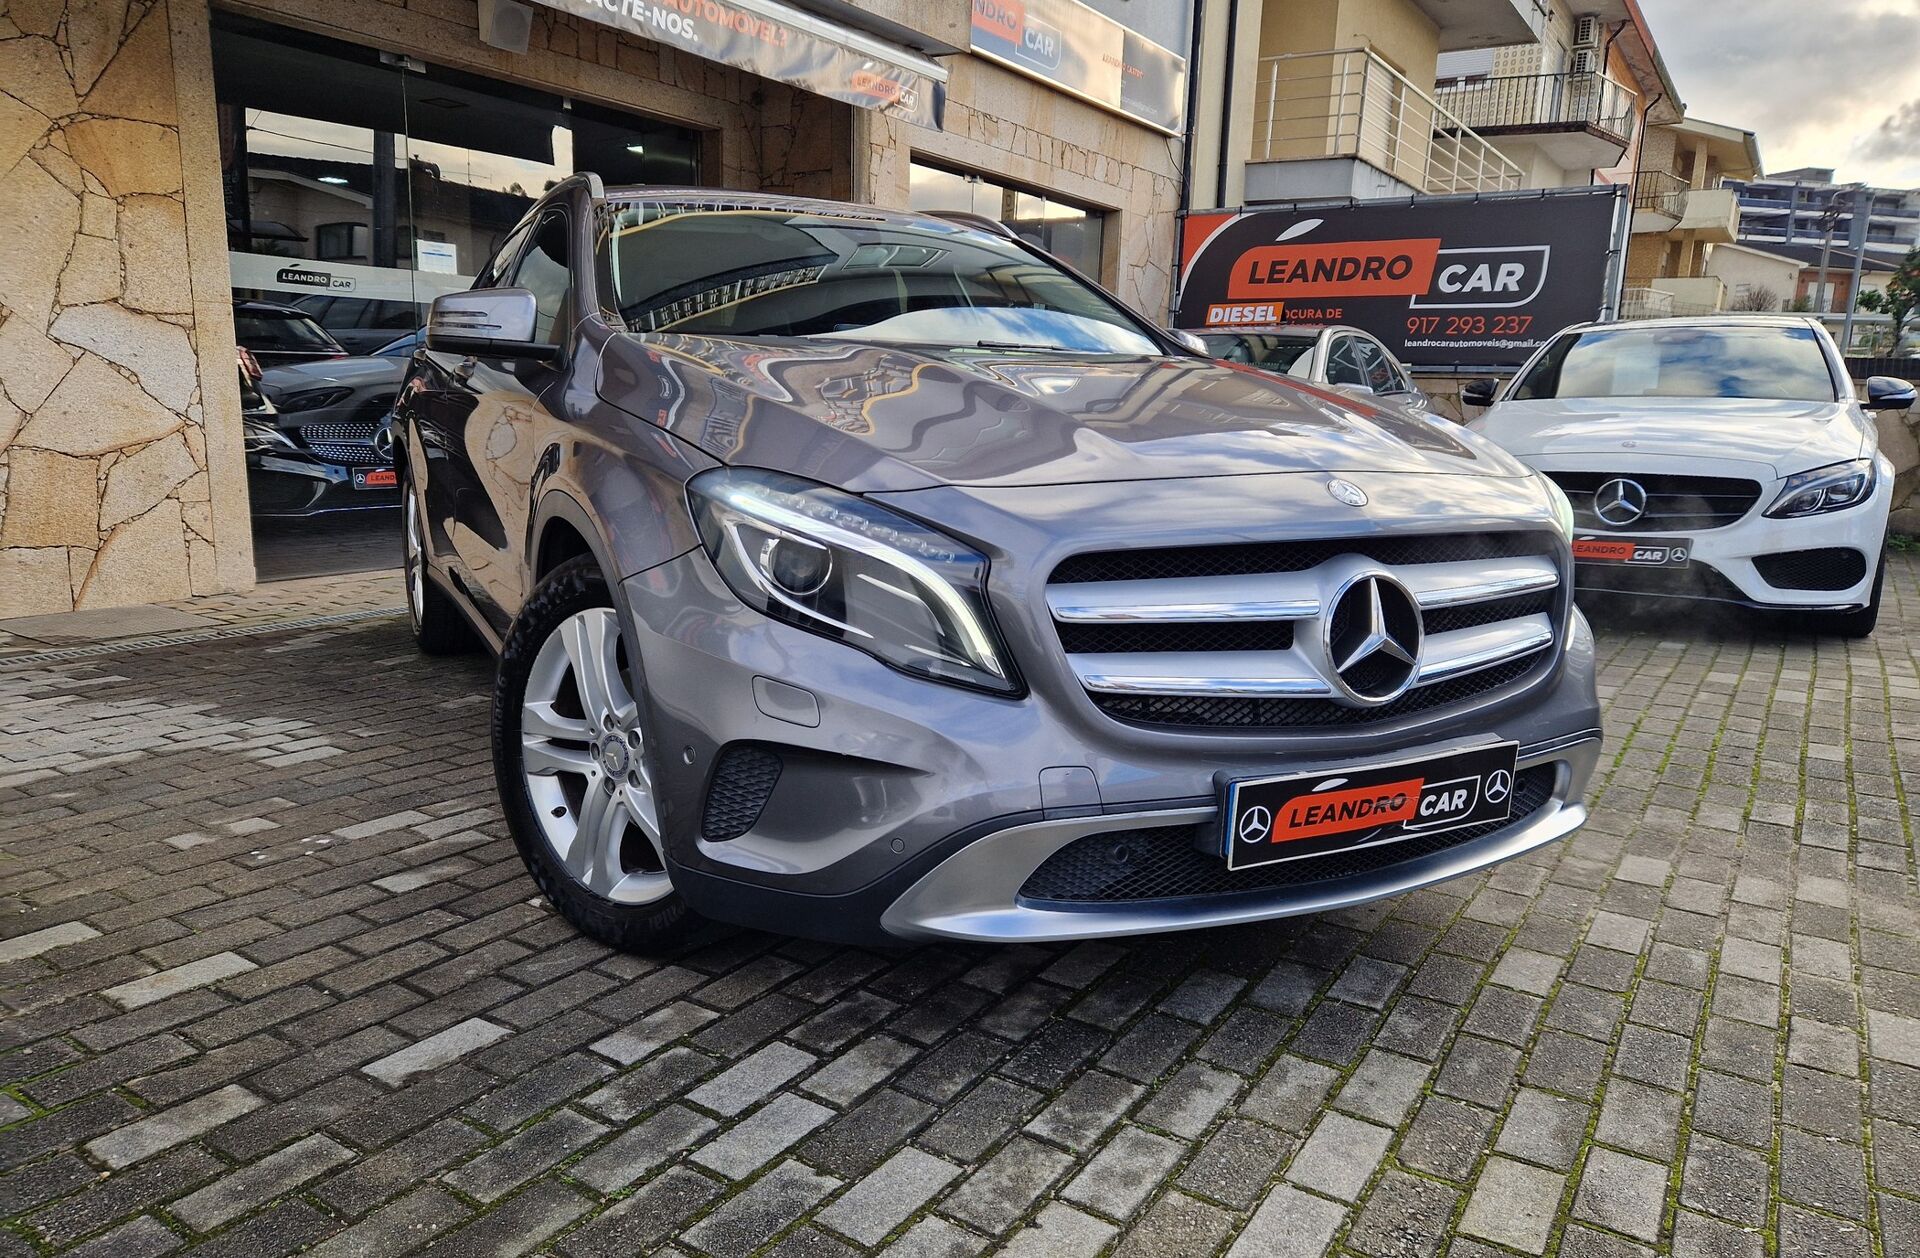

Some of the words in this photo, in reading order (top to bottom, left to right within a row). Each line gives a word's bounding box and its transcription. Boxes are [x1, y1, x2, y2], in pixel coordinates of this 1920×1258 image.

[1025, 27, 1054, 58] CAR
[900, 91, 914, 106] CAR
[282, 272, 327, 284] LEANDRO
[332, 280, 351, 288] CAR
[1248, 254, 1413, 285] LEANDRO
[1438, 262, 1525, 294] CAR
[1209, 305, 1278, 323] DIESEL
[1326, 308, 1343, 319] DE
[1407, 316, 1440, 334] 917
[1446, 316, 1486, 335] 293
[1491, 315, 1534, 334] 237
[1633, 550, 1663, 560] CAR
[1288, 792, 1406, 829] LEANDRO
[1419, 787, 1468, 817] CAR
